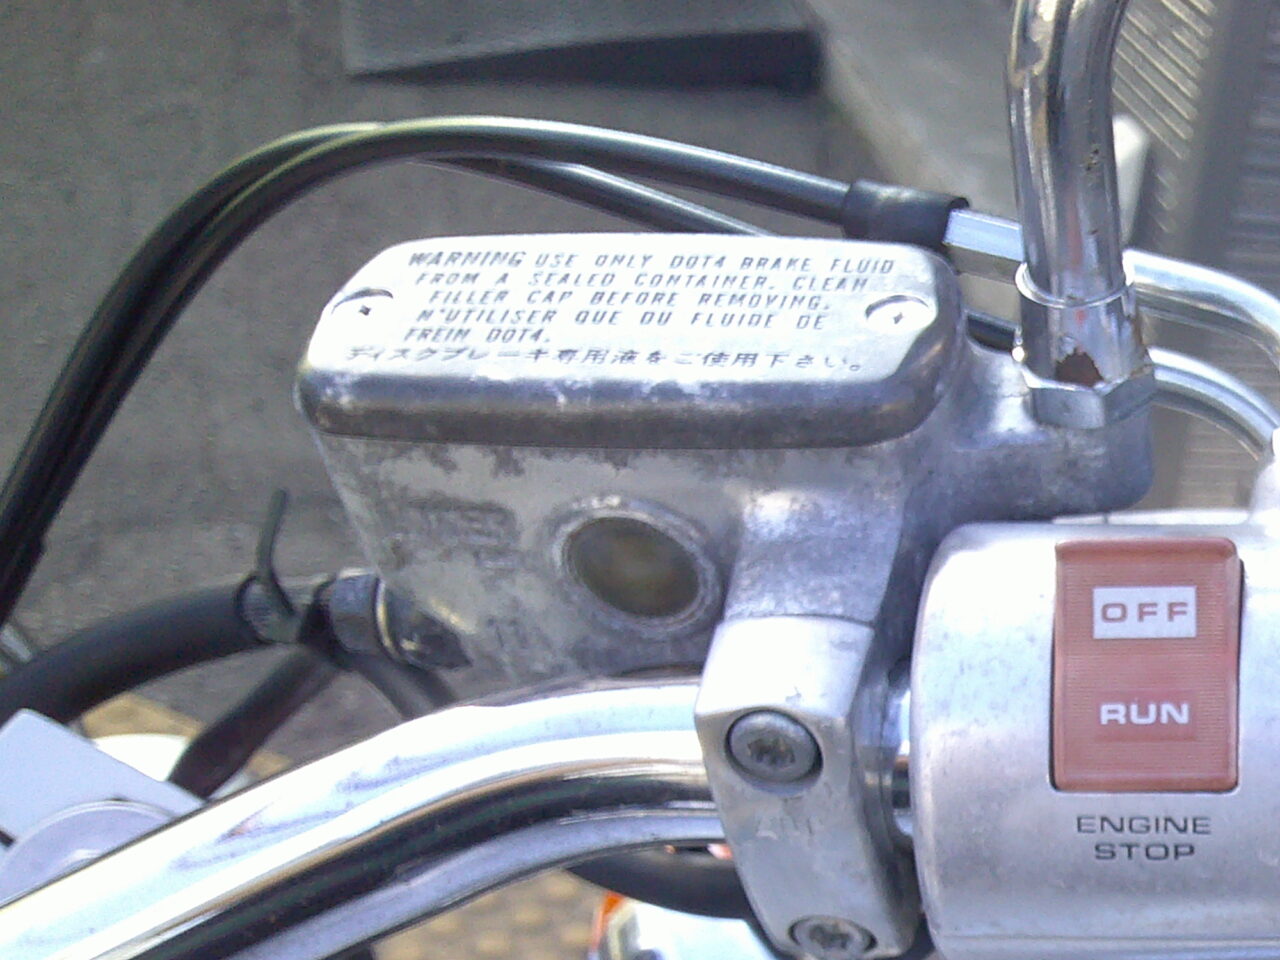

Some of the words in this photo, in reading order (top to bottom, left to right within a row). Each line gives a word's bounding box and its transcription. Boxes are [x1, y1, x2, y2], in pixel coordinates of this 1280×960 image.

[408, 251, 526, 268] WARNING
[535, 254, 577, 268] USE
[595, 254, 653, 269] ONLY
[670, 254, 727, 269] DOT4
[741, 256, 812, 271] BRAKE
[830, 258, 895, 274] FLUID
[415, 271, 480, 286] FROM
[496, 272, 509, 285] A
[528, 272, 615, 287] SEALED
[634, 273, 776, 291] CONTAINER.
[792, 276, 868, 292] CLEAN
[429, 290, 509, 305] FILLER
[526, 290, 573, 305] CAP
[590, 291, 679, 307] BEFORE
[697, 293, 831, 311] REMOVING.
[575, 309, 622, 325] QUE
[640, 311, 673, 326] DU
[690, 312, 776, 329] FLUIDE
[796, 314, 826, 330] DE
[403, 327, 471, 342] FREIN
[486, 328, 552, 343] DOT4.
[1101, 602, 1188, 623] OFF
[1100, 702, 1190, 725] RUN
[1076, 815, 1212, 834] ENGINE
[1094, 843, 1195, 861] STOP
